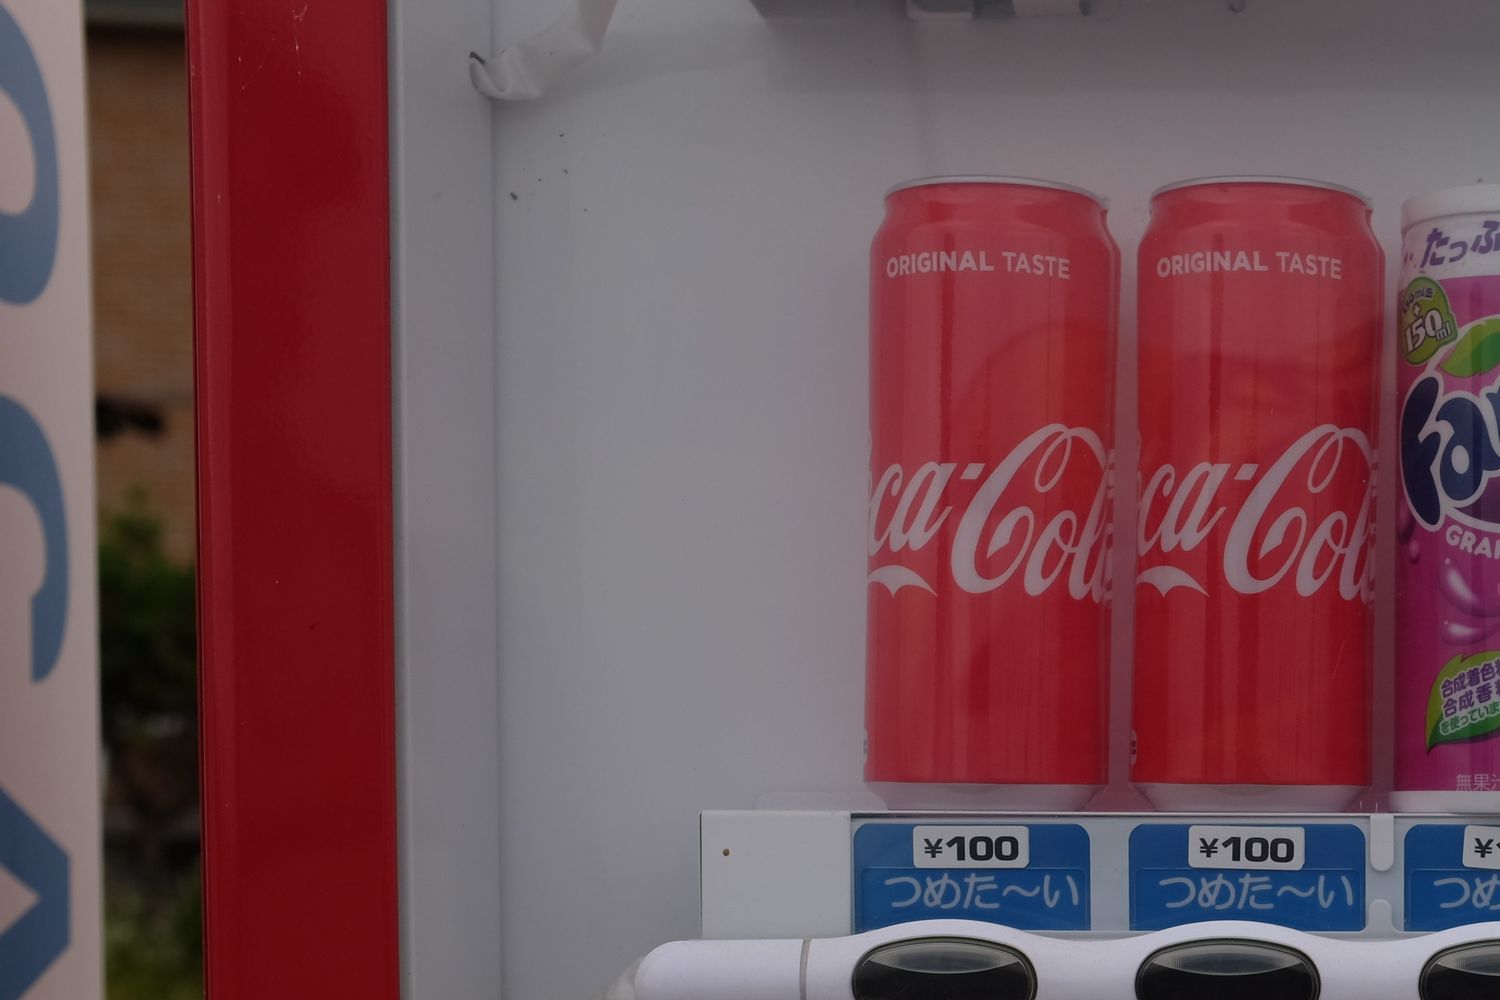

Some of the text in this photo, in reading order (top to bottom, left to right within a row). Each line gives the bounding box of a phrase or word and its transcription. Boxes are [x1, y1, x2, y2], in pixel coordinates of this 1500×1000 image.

[886, 251, 1070, 280] ORIGINAL TASTE
[1157, 250, 1341, 280] ORIGINAL TASTE
[924, 836, 1020, 862] ¥100
[1199, 837, 1295, 863] ¥100
